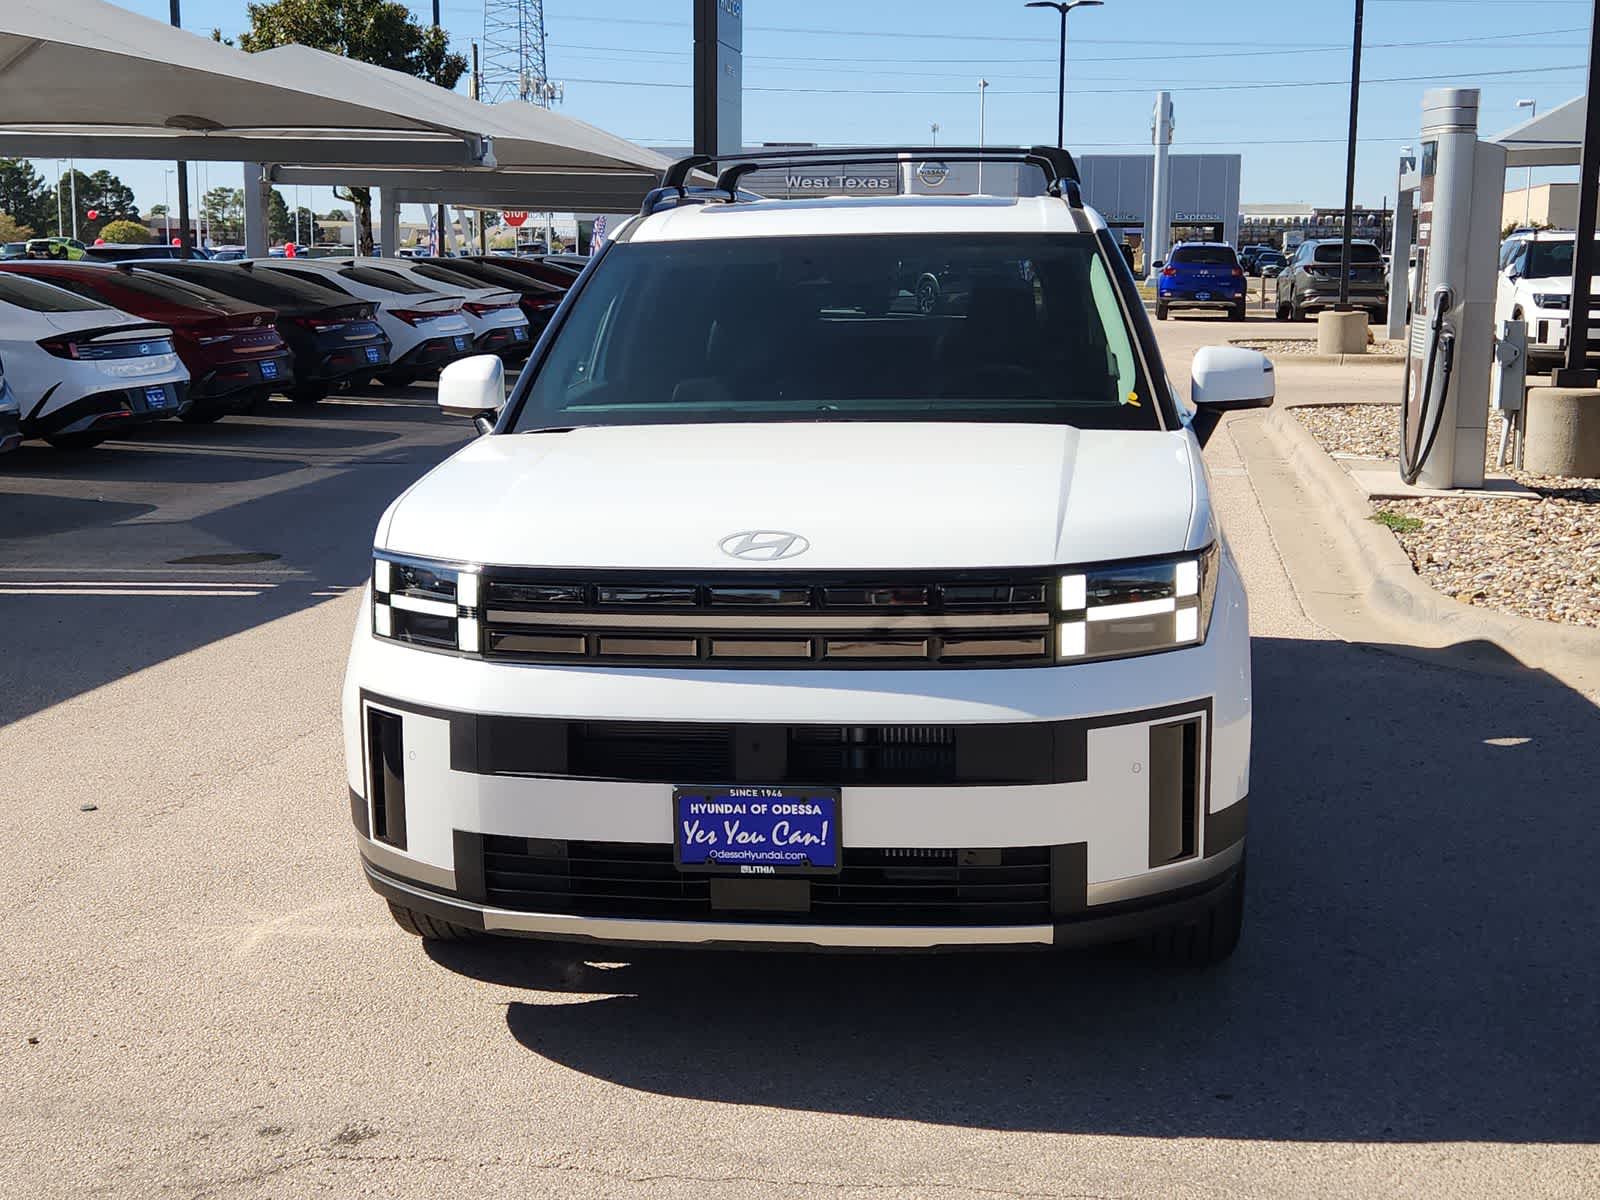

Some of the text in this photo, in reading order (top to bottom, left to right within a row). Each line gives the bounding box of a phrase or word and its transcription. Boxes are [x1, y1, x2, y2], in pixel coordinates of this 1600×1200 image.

[919, 168, 946, 176] NISSAN
[785, 176, 889, 188] West Texas
[730, 789, 782, 798] SINCE 1946
[691, 803, 822, 815] HYUNDAI OF ODESSA
[683, 820, 829, 846] Yes You Can!
[709, 849, 807, 860] OdessaHyundai.com
[749, 865, 775, 874] LITHIA
